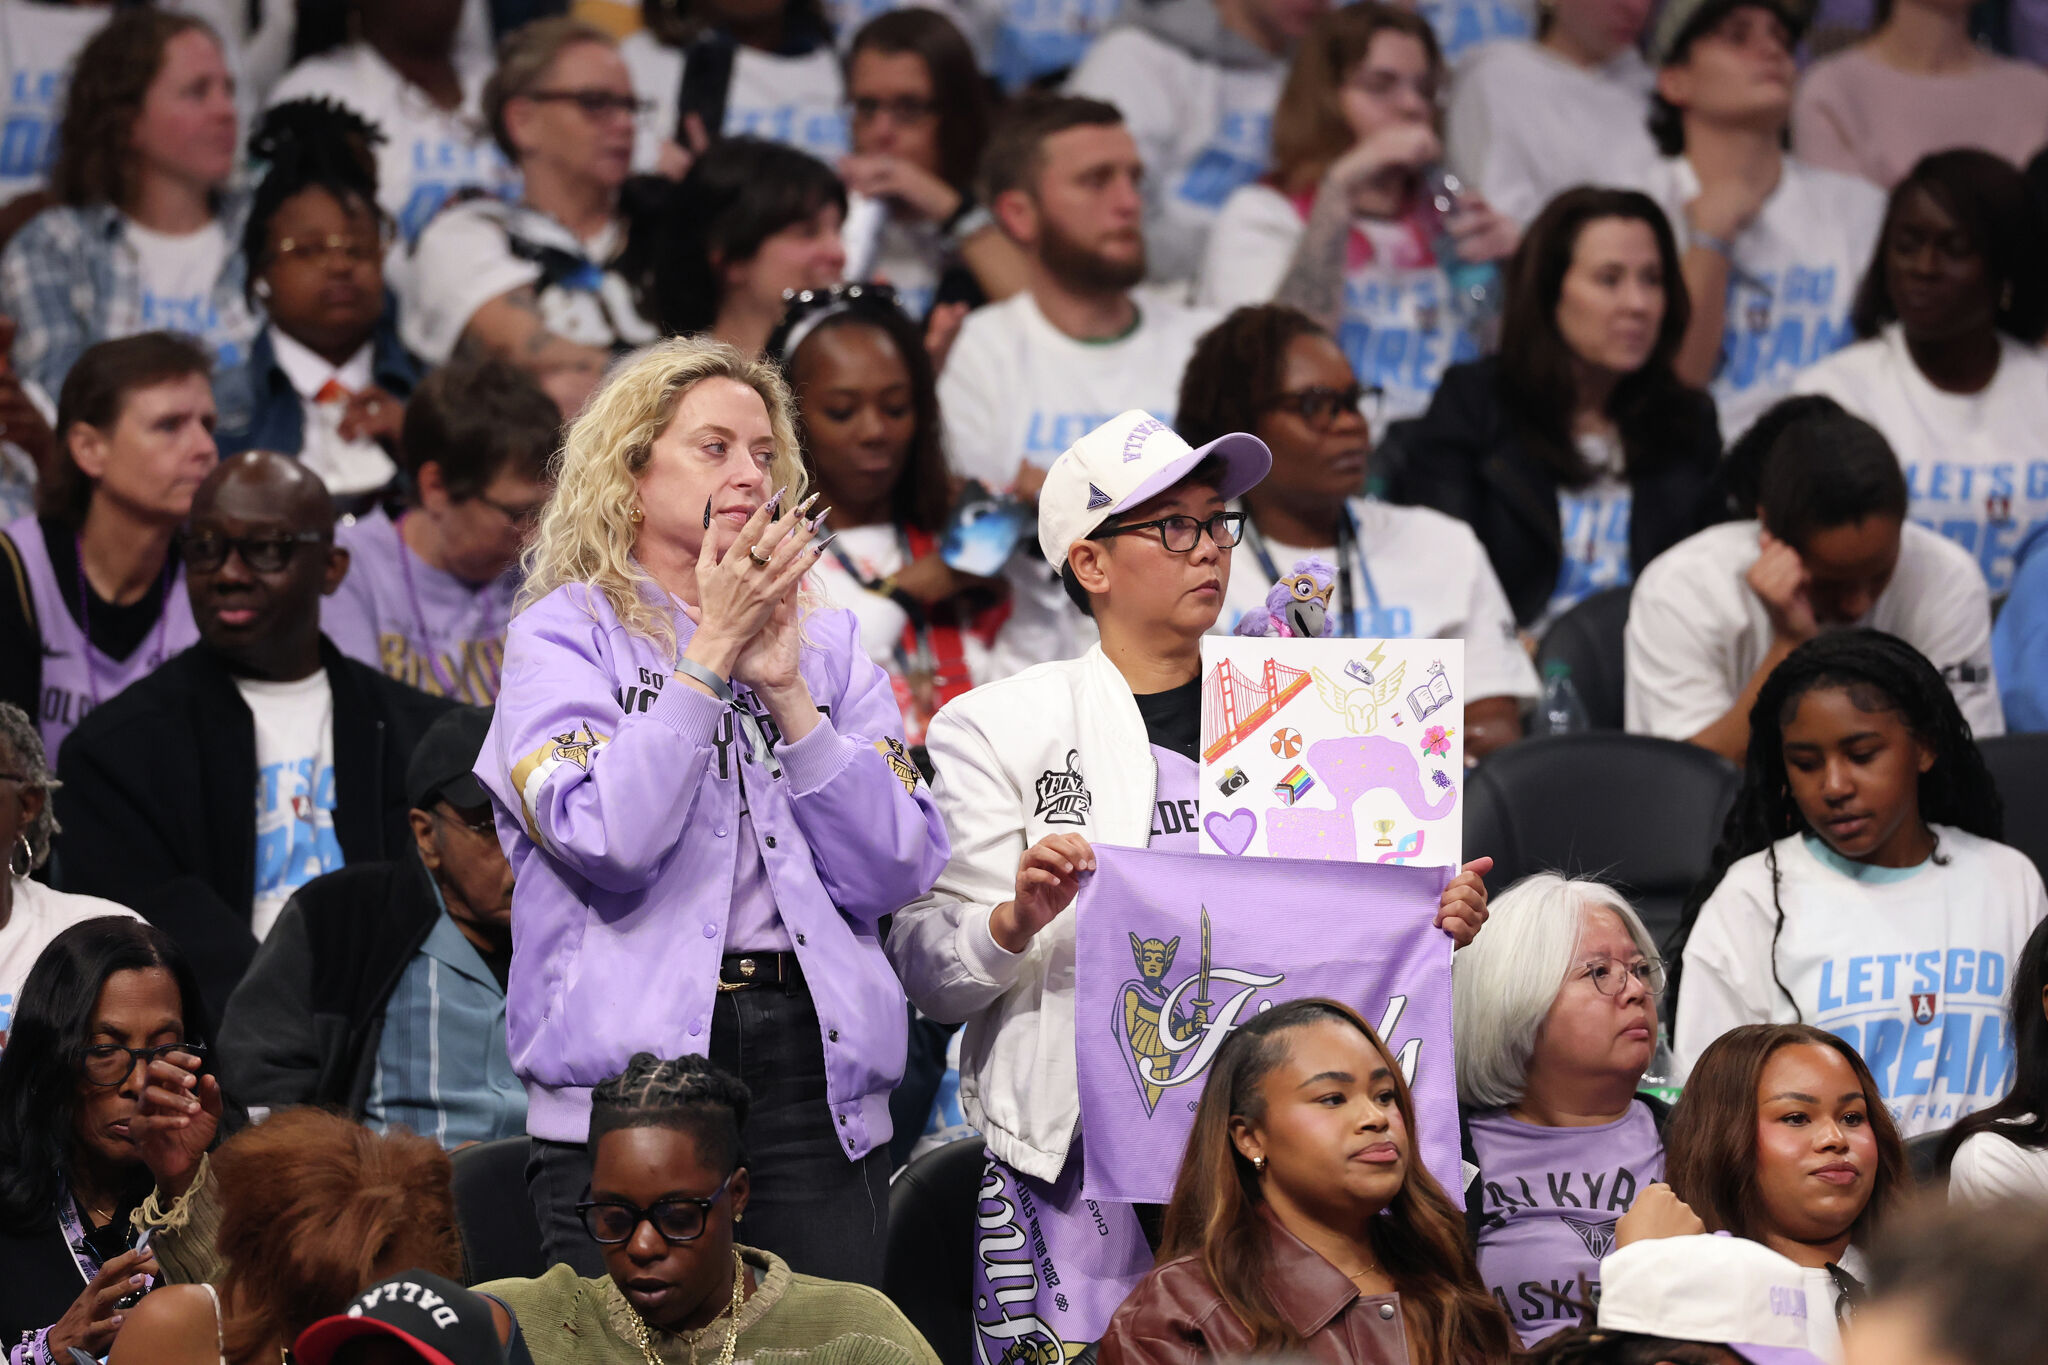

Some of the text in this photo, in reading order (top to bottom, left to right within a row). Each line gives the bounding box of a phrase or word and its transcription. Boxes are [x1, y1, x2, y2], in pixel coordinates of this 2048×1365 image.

[1122, 418, 1182, 464] HALLA
[2026, 461, 2048, 500] G
[1047, 774, 1089, 798] FINA
[1818, 947, 2005, 1013] LET'S GO
[1016, 1182, 1061, 1290] 2026 GOLDEN STATE
[1086, 1198, 1109, 1237] CHAS
